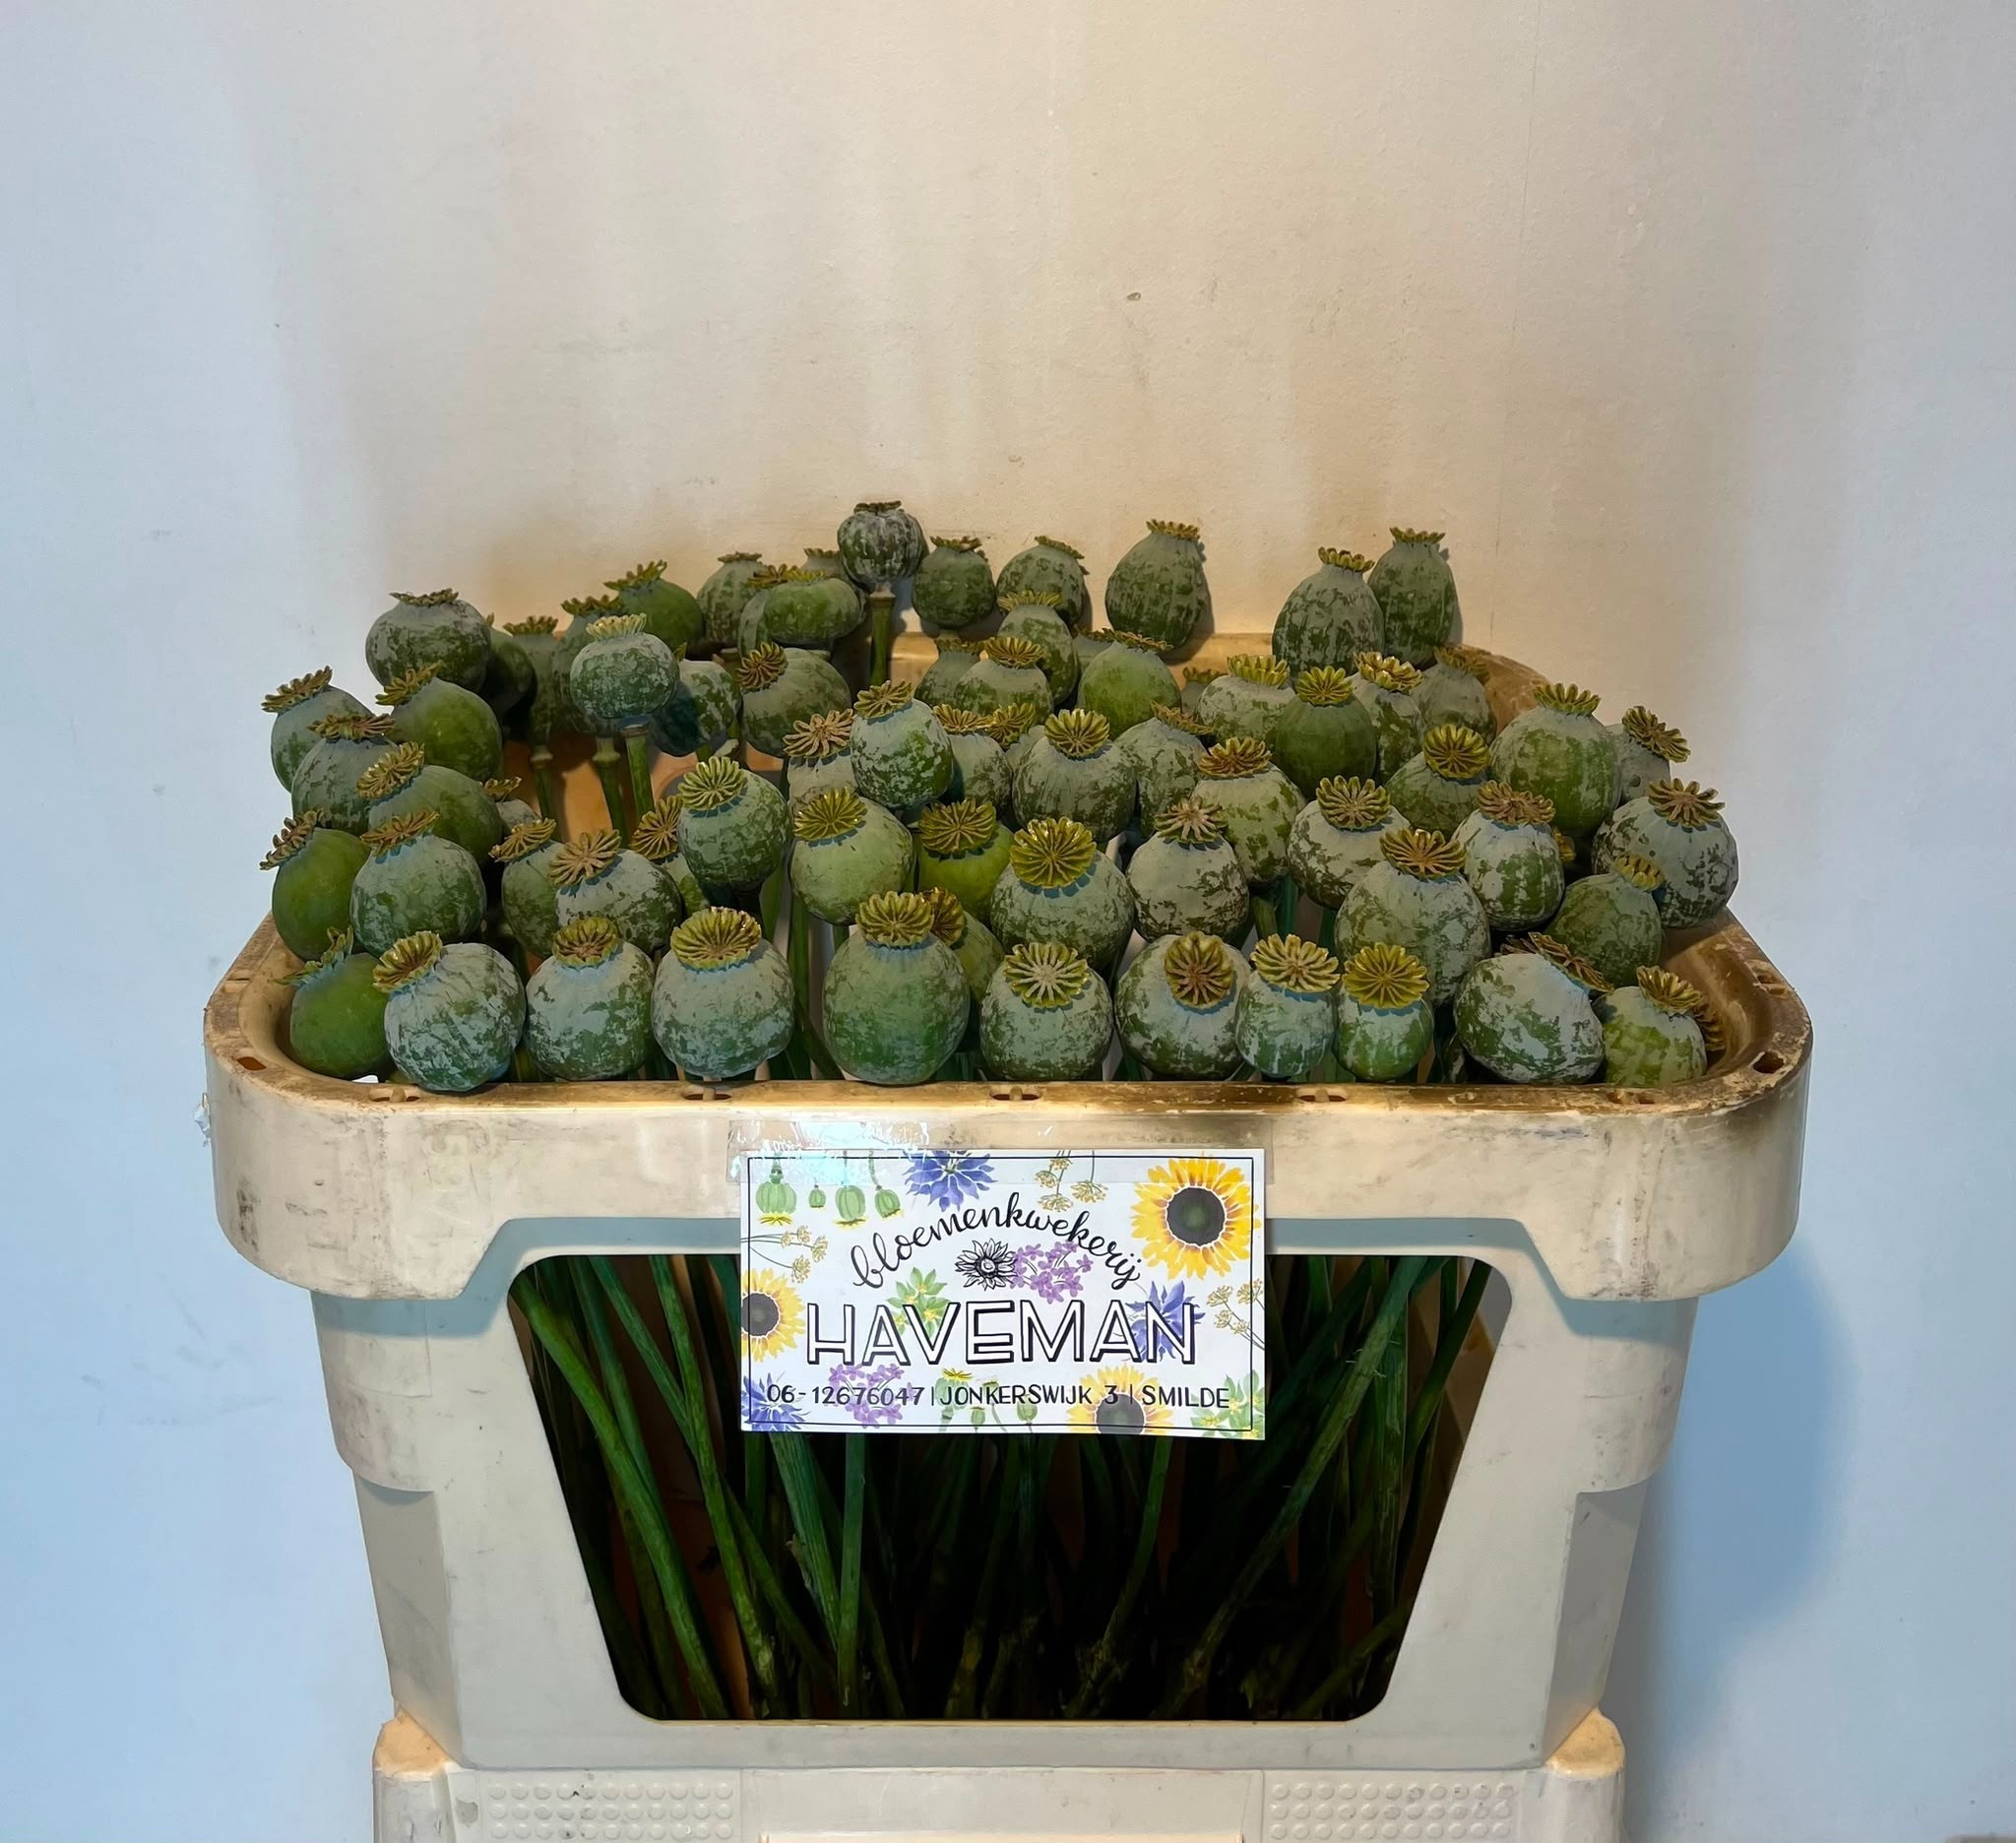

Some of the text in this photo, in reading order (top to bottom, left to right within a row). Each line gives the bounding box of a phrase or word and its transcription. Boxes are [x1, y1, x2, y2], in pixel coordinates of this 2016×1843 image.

[850, 1191, 1141, 1291] bloemenkwekerij
[807, 1299, 1198, 1366] HAVEMAN
[939, 1383, 1093, 1407] JONKERSWIJK
[1103, 1384, 1119, 1405] 3
[1141, 1384, 1230, 1409] SMILDE
